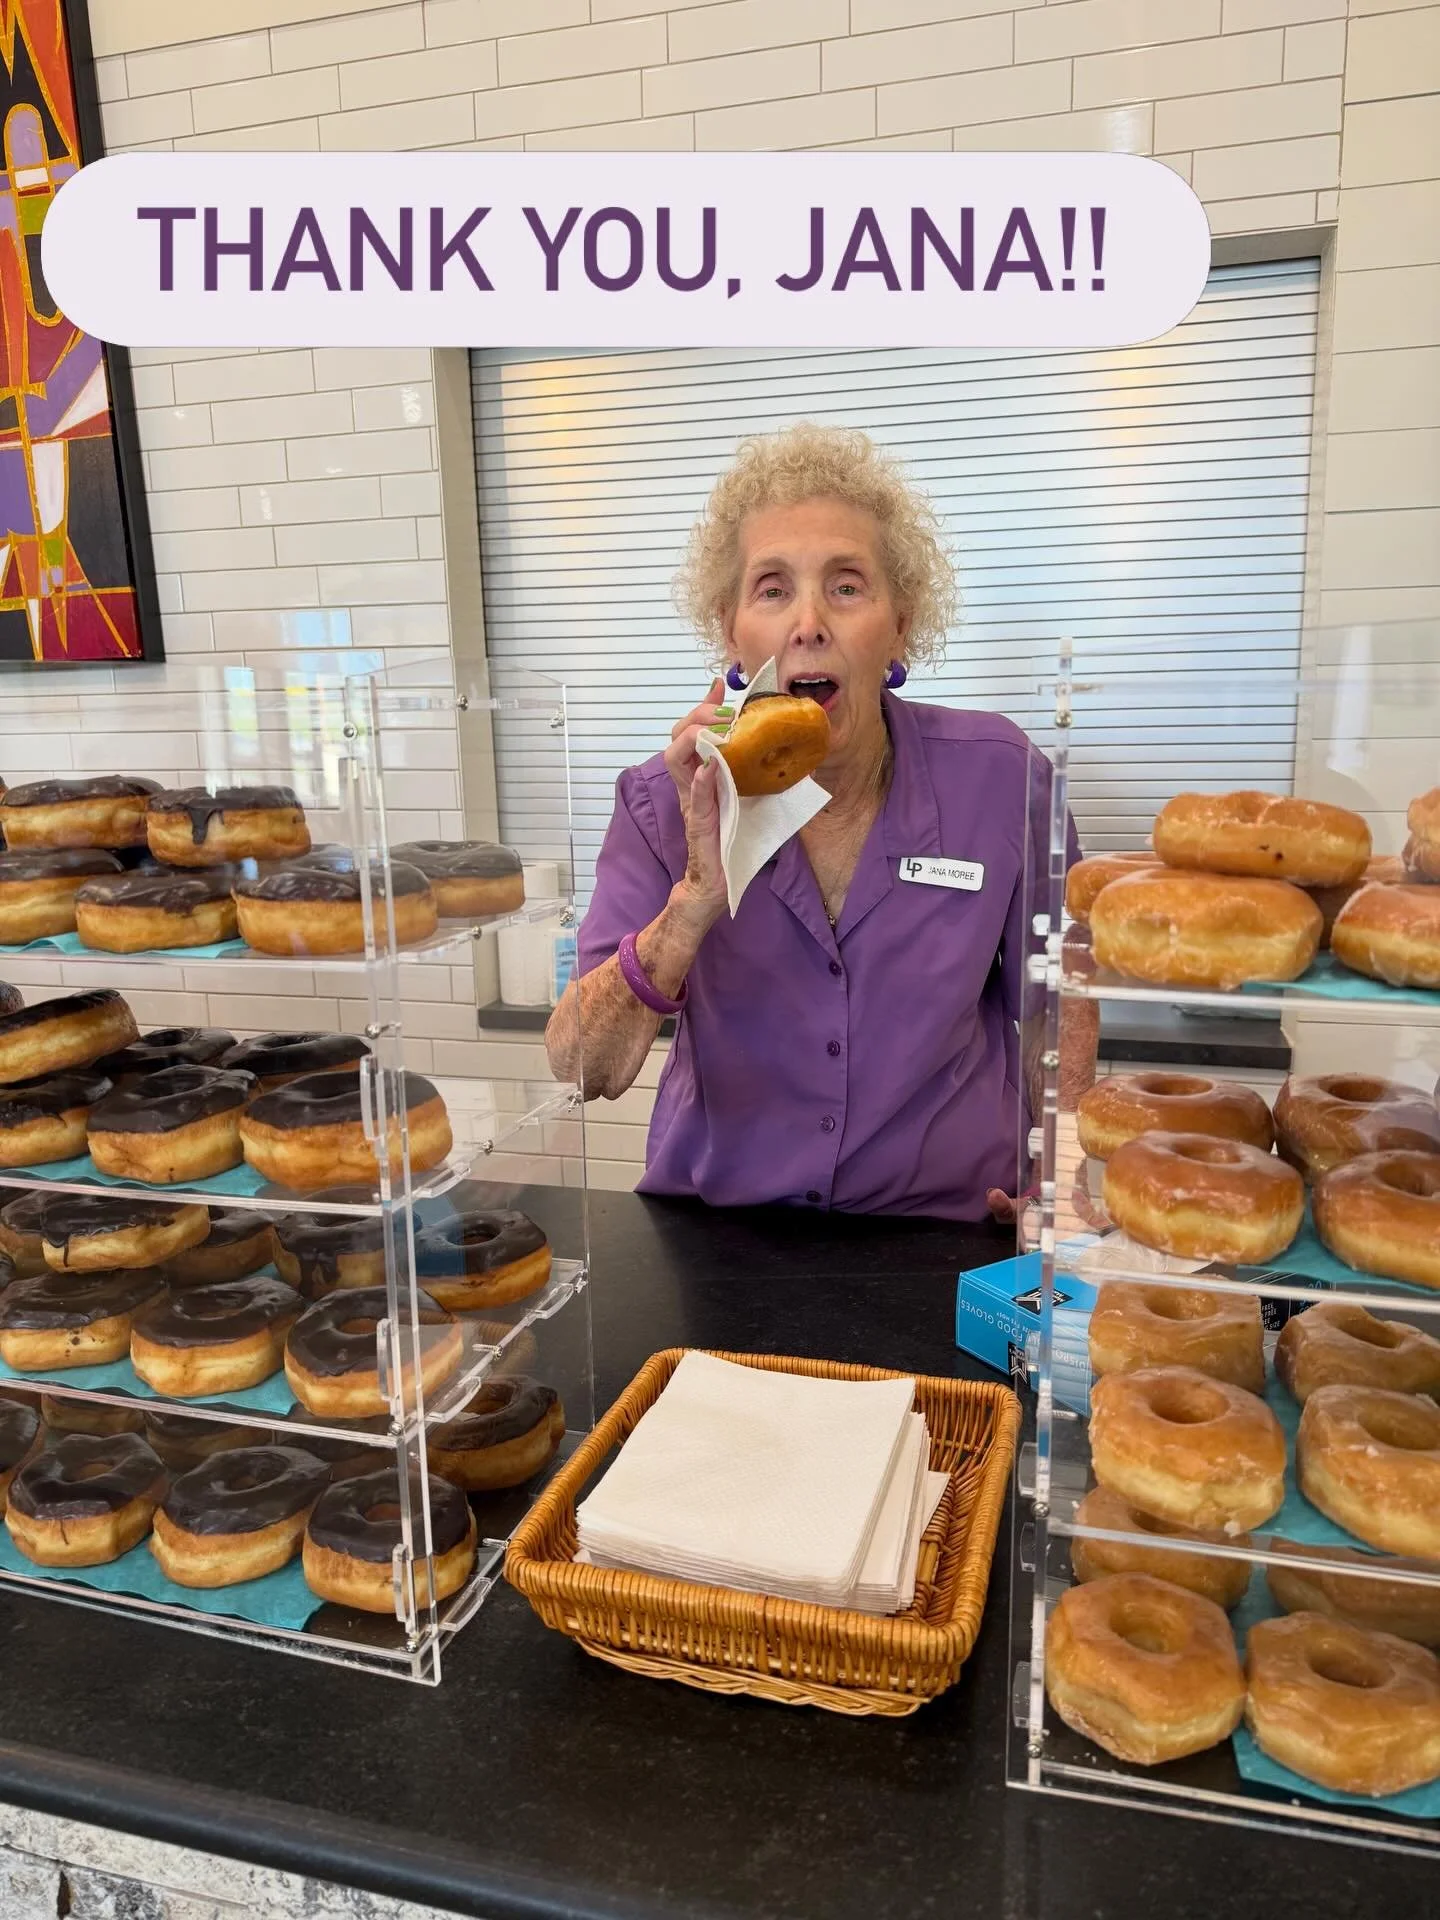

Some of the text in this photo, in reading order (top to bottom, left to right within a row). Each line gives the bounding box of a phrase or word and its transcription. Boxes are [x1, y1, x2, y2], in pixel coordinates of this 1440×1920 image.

[906, 858, 923, 878] LP
[960, 1298, 995, 1325] GLOVES
[997, 1320, 1024, 1342] FOOD
